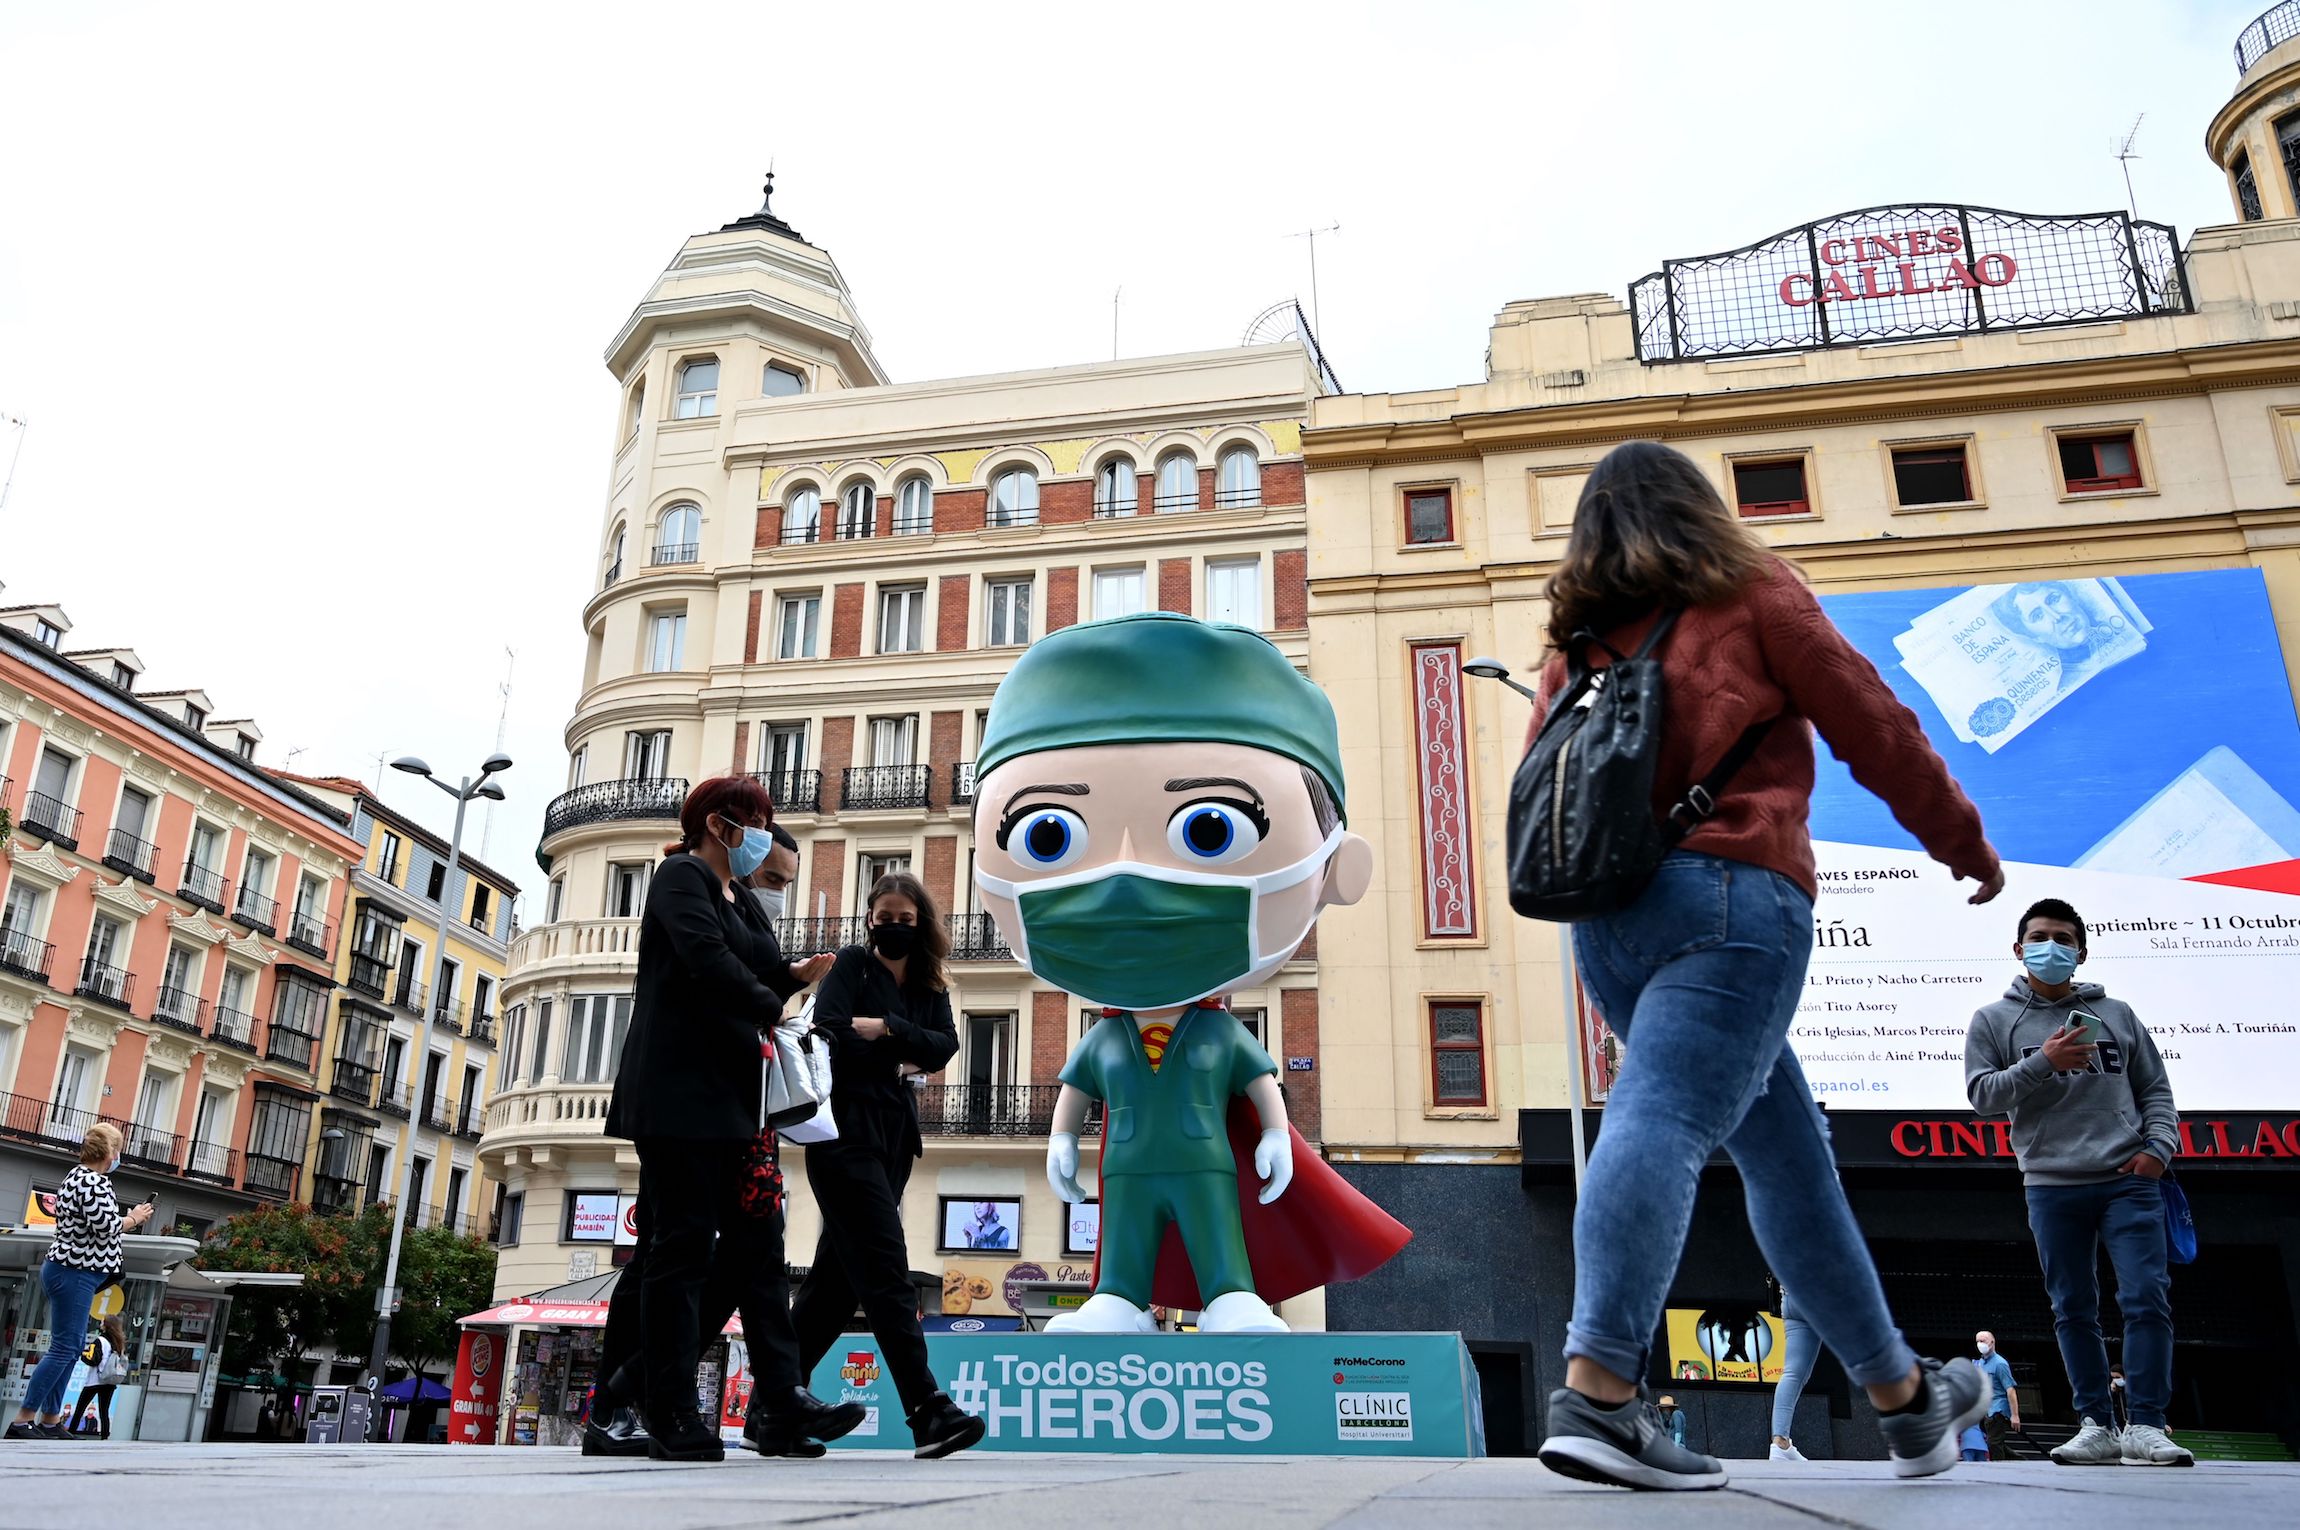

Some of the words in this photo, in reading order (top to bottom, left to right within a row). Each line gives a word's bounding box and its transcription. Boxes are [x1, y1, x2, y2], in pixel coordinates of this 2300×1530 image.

[1820, 226, 1963, 266] CINES
[1779, 253, 2017, 307] CALLAO
[1952, 616, 1987, 646] BANCO
[1962, 638, 1980, 655] DE
[1971, 634, 2011, 664] ESPAÑA
[2006, 656, 2060, 699] QUINIENTAS
[2014, 677, 2051, 709] pesetas
[965, 765, 975, 778] AL
[1815, 871, 1849, 881] AVES
[1854, 868, 1920, 880] ESPAÑOL
[1821, 883, 1875, 895] Matadero
[1815, 918, 1873, 948] iña
[2086, 916, 2179, 937] eptiembre
[2202, 916, 2223, 930] 11
[2150, 936, 2179, 950] Sala
[2183, 935, 2252, 949] Fernando
[2256, 934, 2300, 948] Arrab
[1809, 975, 1823, 986] L.
[1825, 975, 1864, 986] Prieto
[1867, 978, 1874, 988] y
[1878, 974, 1918, 985] Nacho
[1921, 974, 1983, 985] Carretero
[1797, 1002, 1822, 1012] ción
[1824, 1001, 1852, 1012] Tito
[1856, 1001, 1898, 1014] Asorey
[1796, 1026, 1822, 1037] Cris
[1825, 1026, 1871, 1040] Iglesias,
[1873, 1026, 1918, 1037] Marcos
[2147, 1025, 2166, 1034] eta
[2169, 1026, 2176, 1038] y
[2180, 1022, 2212, 1034] Xosé
[2215, 1023, 2230, 1034] A.
[2232, 1021, 2296, 1034] Touriñán
[1799, 1050, 1865, 1065] producción
[1868, 1050, 1882, 1061] de
[1885, 1050, 1915, 1061] Ainé
[1918, 1050, 1965, 1061] Produc
[2160, 1048, 2182, 1060] dia
[1810, 1078, 1890, 1095] spanol.es
[1891, 1120, 2017, 1158] CINE
[2172, 1119, 2300, 1158] LLA
[576, 1203, 585, 1211] LA
[575, 1213, 617, 1221] PUBLICIDAD
[574, 1222, 605, 1232] TAMBIÉN
[1057, 1264, 1092, 1282] Paste
[539, 1308, 594, 1320] GRAN
[1333, 1356, 1406, 1367] #YoMeCorono
[840, 1364, 881, 1381] minis
[453, 1399, 474, 1415] GRAN
[1339, 1393, 1408, 1416] CLÍNIC
[1341, 1419, 1408, 1427] BARCELONA
[1341, 1431, 1368, 1439] Hospital
